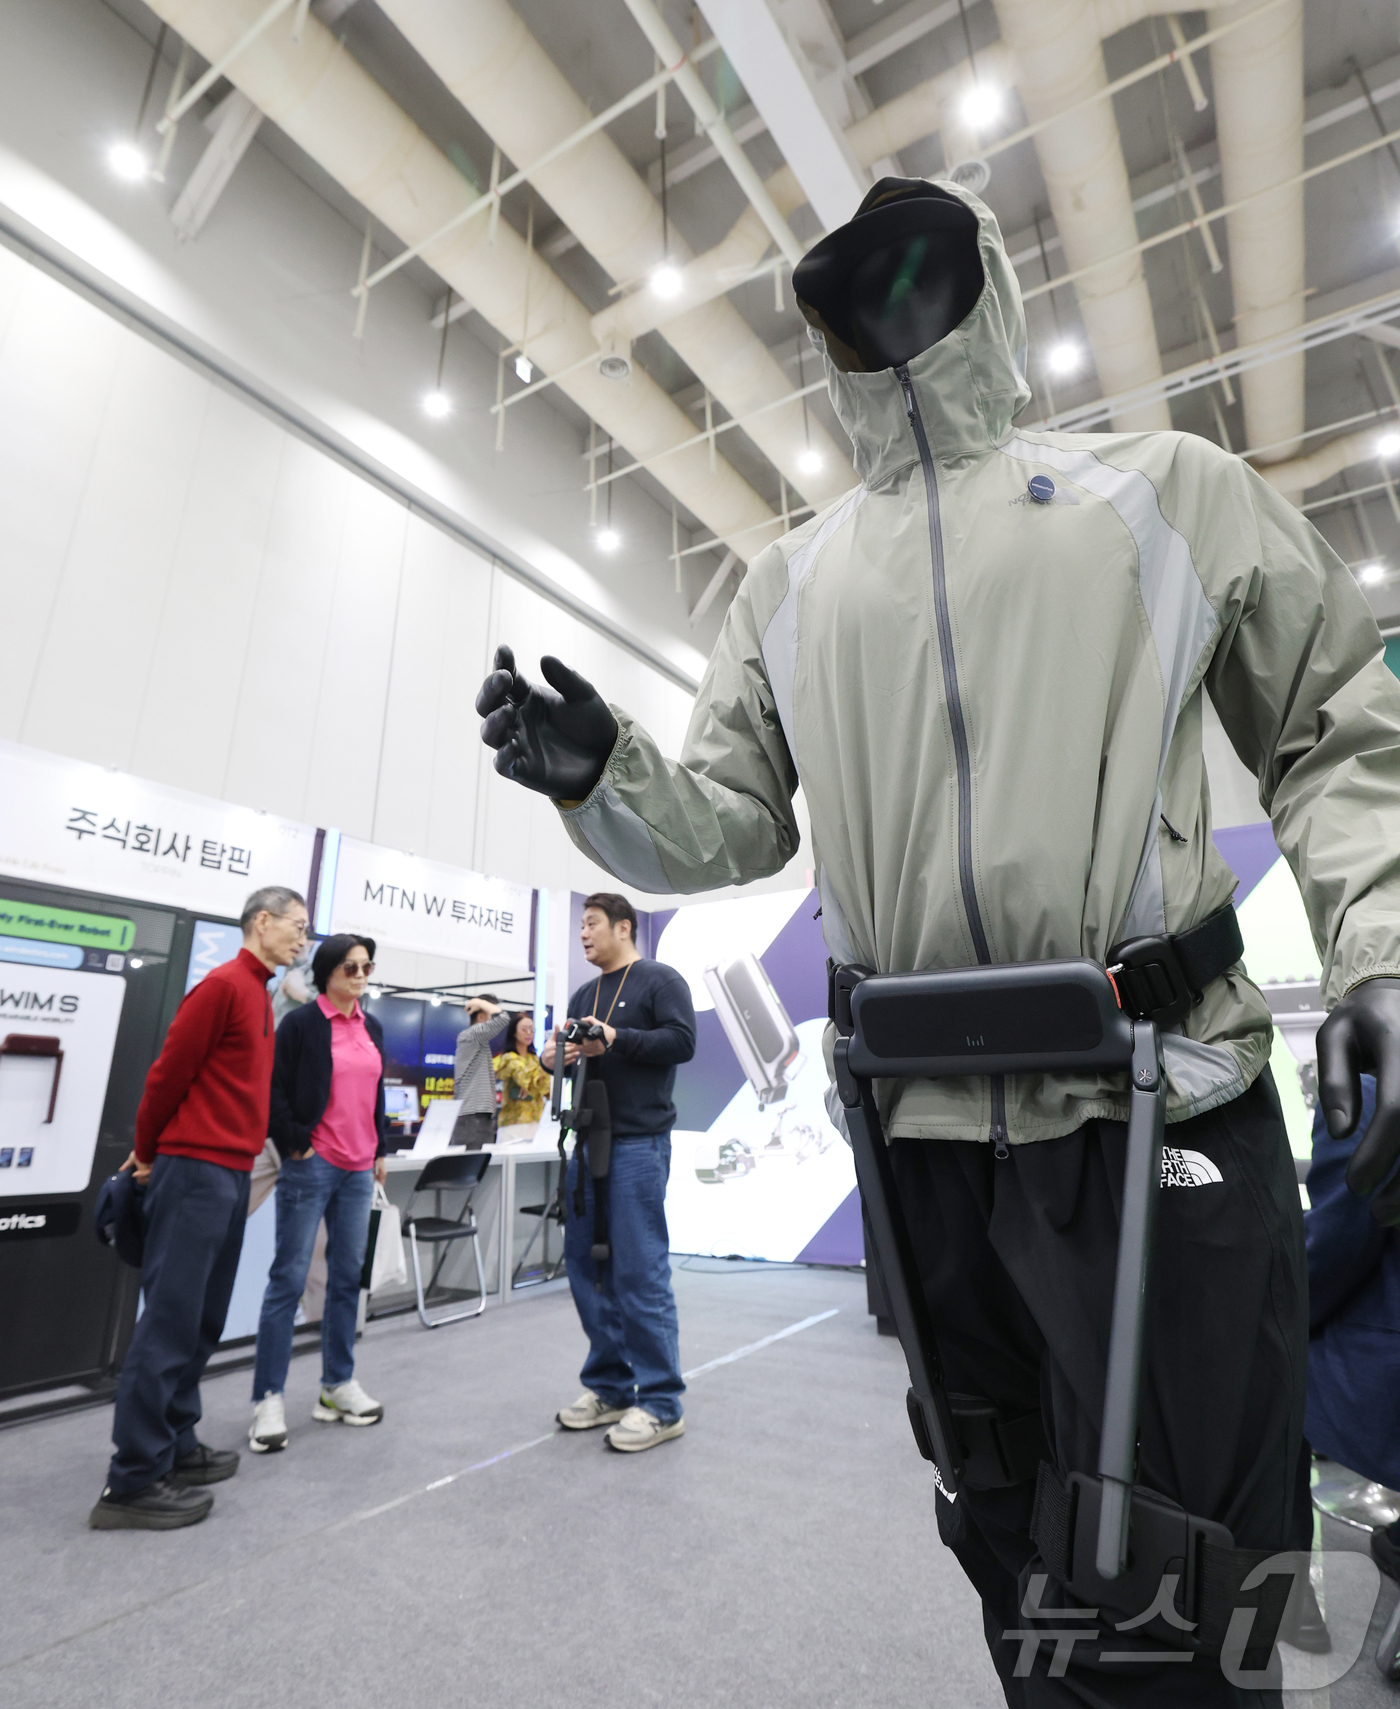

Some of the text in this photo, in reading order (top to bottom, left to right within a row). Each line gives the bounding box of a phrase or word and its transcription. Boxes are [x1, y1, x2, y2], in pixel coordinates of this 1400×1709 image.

[65, 806, 252, 877] 주식회사 탑핀
[364, 879, 514, 934] MTN W 투자자문
[1162, 1145, 1184, 1161] THE
[1161, 1160, 1190, 1174] RTH
[1160, 1173, 1196, 1189] FACE
